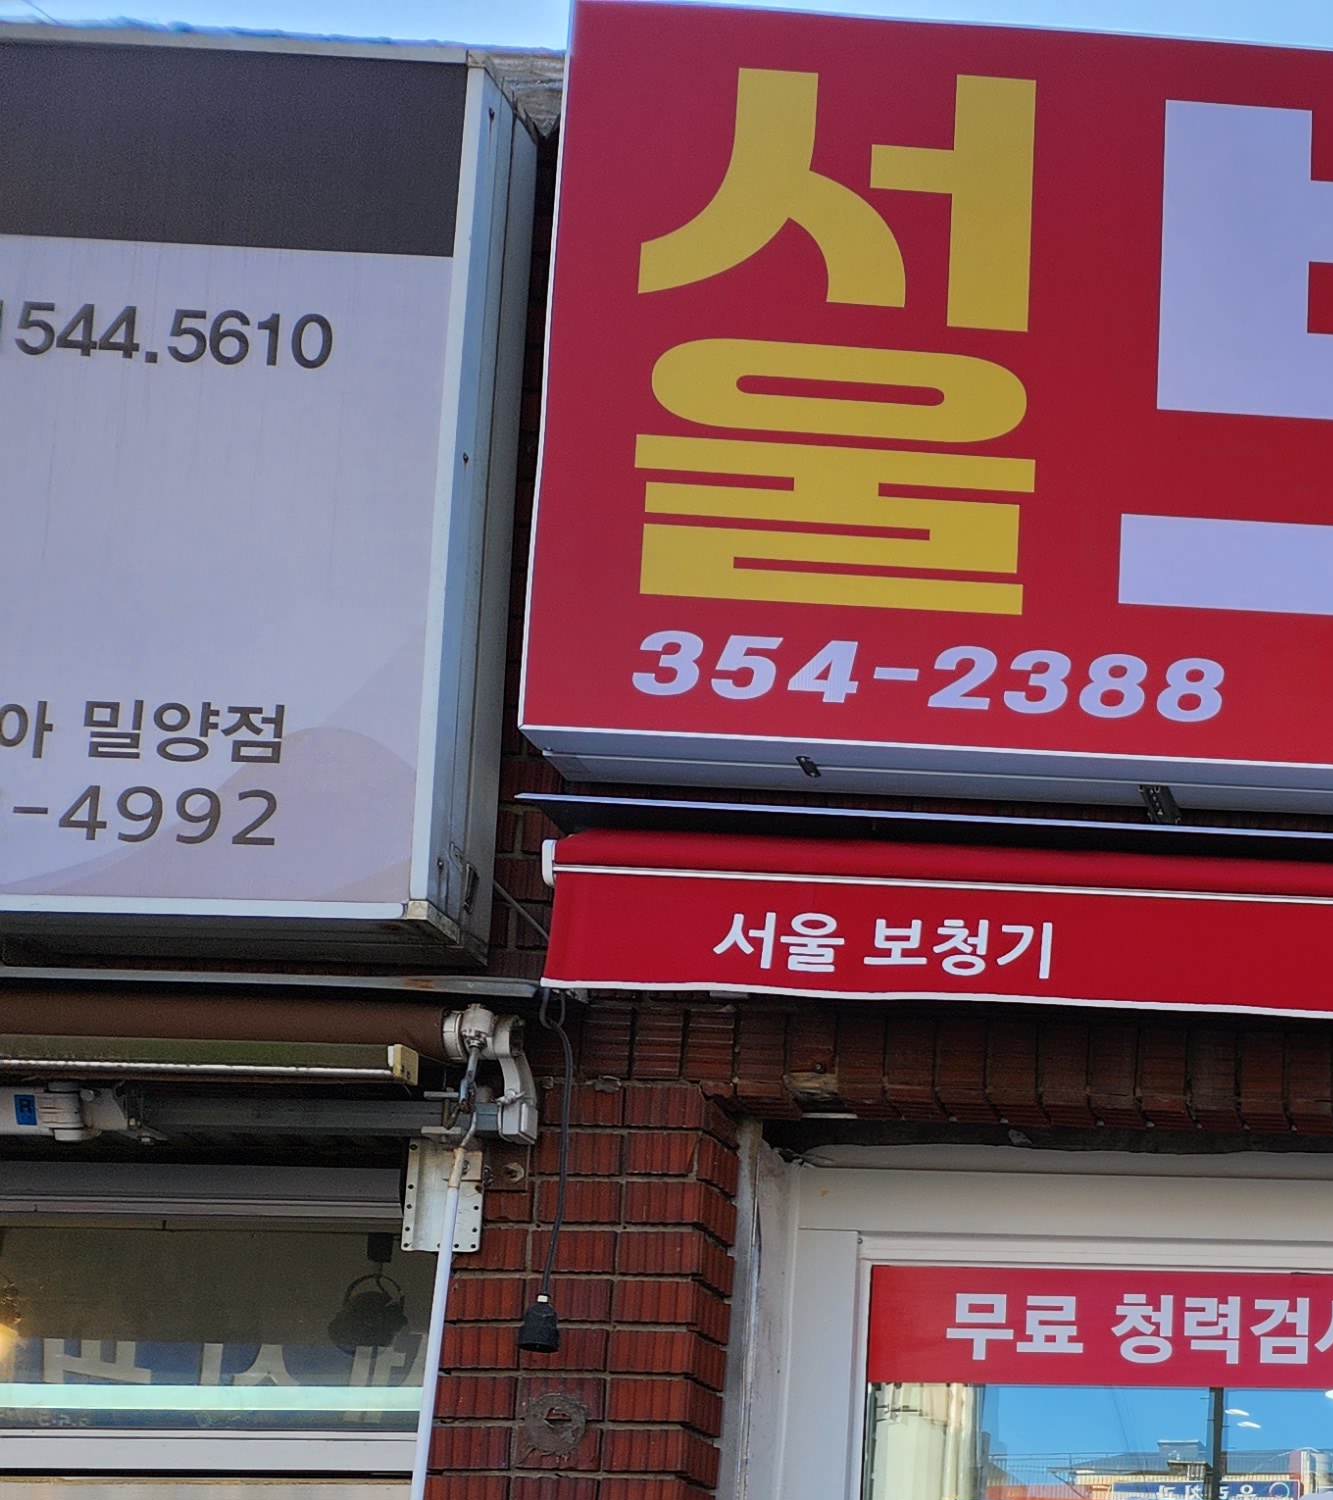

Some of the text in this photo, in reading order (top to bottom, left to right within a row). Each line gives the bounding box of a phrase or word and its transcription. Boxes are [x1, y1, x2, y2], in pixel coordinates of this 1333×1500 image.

[0, 300, 333, 370] 544.5610
[634, 66, 1037, 616] 서울
[631, 629, 1226, 723] 354-2388
[83, 699, 286, 764] 밀양점
[713, 912, 1053, 979] 서울 보청기
[946, 1293, 1084, 1361] 무료
